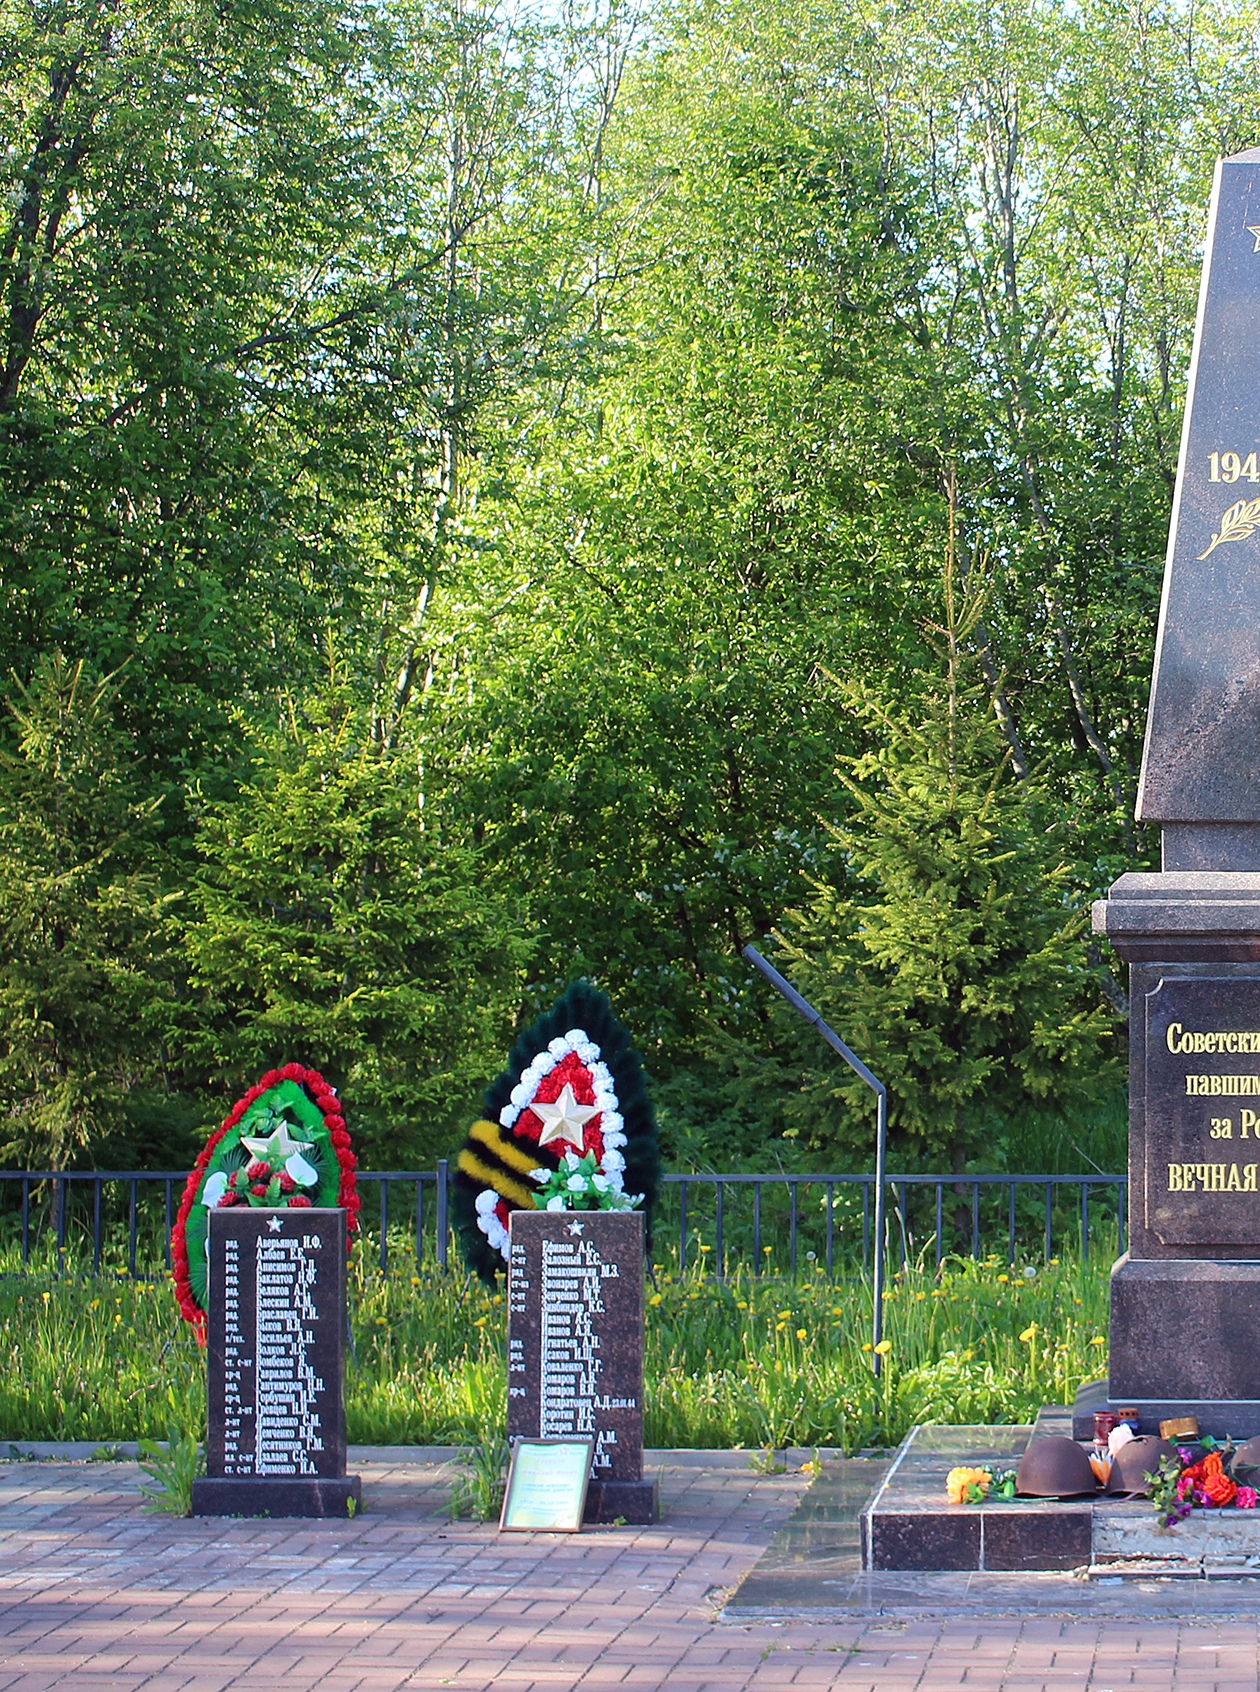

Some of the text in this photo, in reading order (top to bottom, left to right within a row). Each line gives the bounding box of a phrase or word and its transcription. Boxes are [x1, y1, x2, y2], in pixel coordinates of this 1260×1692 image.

[1209, 1117, 1233, 1140] за
[1167, 1162, 1259, 1193] ВЕЧНАЯ
[542, 1240, 574, 1255] Ефимов
[256, 1259, 296, 1272] Анисимов
[541, 1312, 571, 1324] Иванов
[256, 1330, 315, 1343] Васильев А.Н.
[541, 1324, 571, 1336] Иванов
[256, 1342, 285, 1355] Волков
[541, 1359, 584, 1372] Коваленко
[256, 1366, 293, 1381] Гаврилов
[541, 1371, 576, 1385] Комаров
[541, 1383, 576, 1397] Комаров
[255, 1414, 298, 1428] Давиденко
[302, 1414, 321, 1426] С.М.
[255, 1425, 295, 1438] Демченко
[255, 1461, 296, 1476] Ефименко
